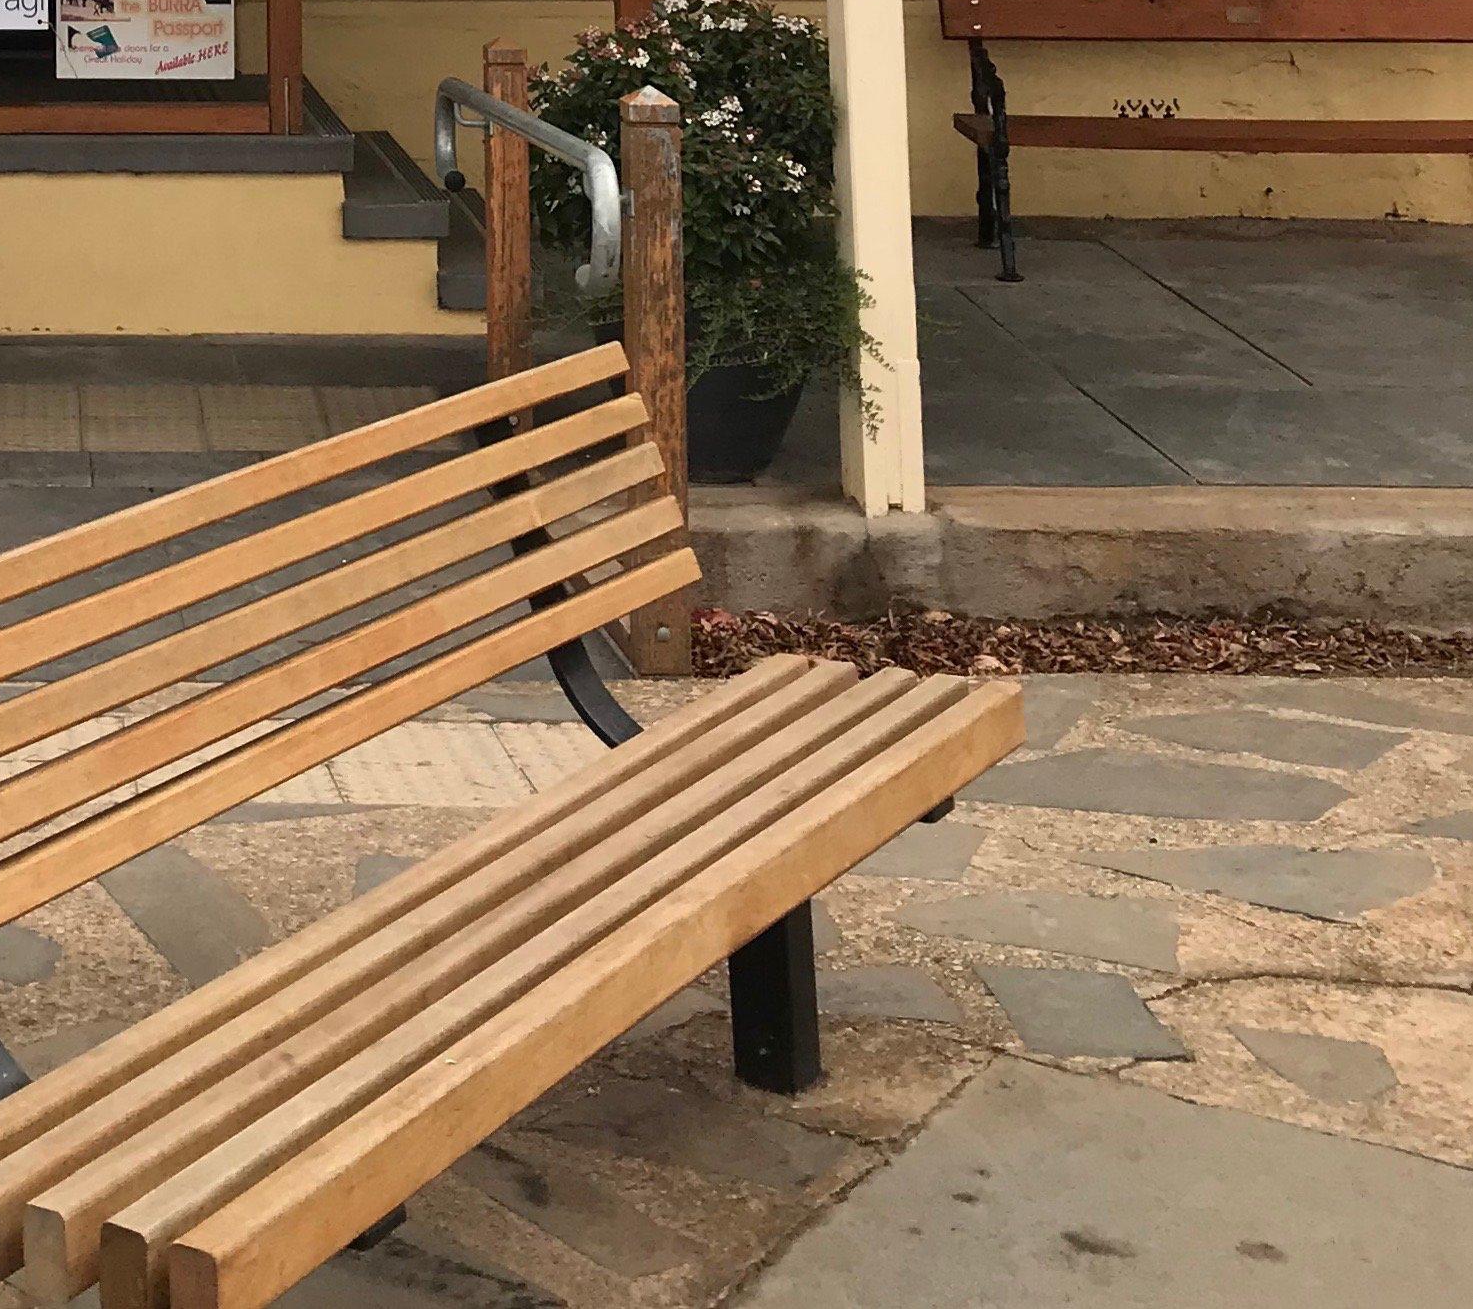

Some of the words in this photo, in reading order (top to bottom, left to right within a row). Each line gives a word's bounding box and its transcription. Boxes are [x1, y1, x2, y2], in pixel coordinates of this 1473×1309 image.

[153, 18, 223, 37] Passport
[155, 53, 195, 75] Available
[198, 41, 229, 63] HERE
